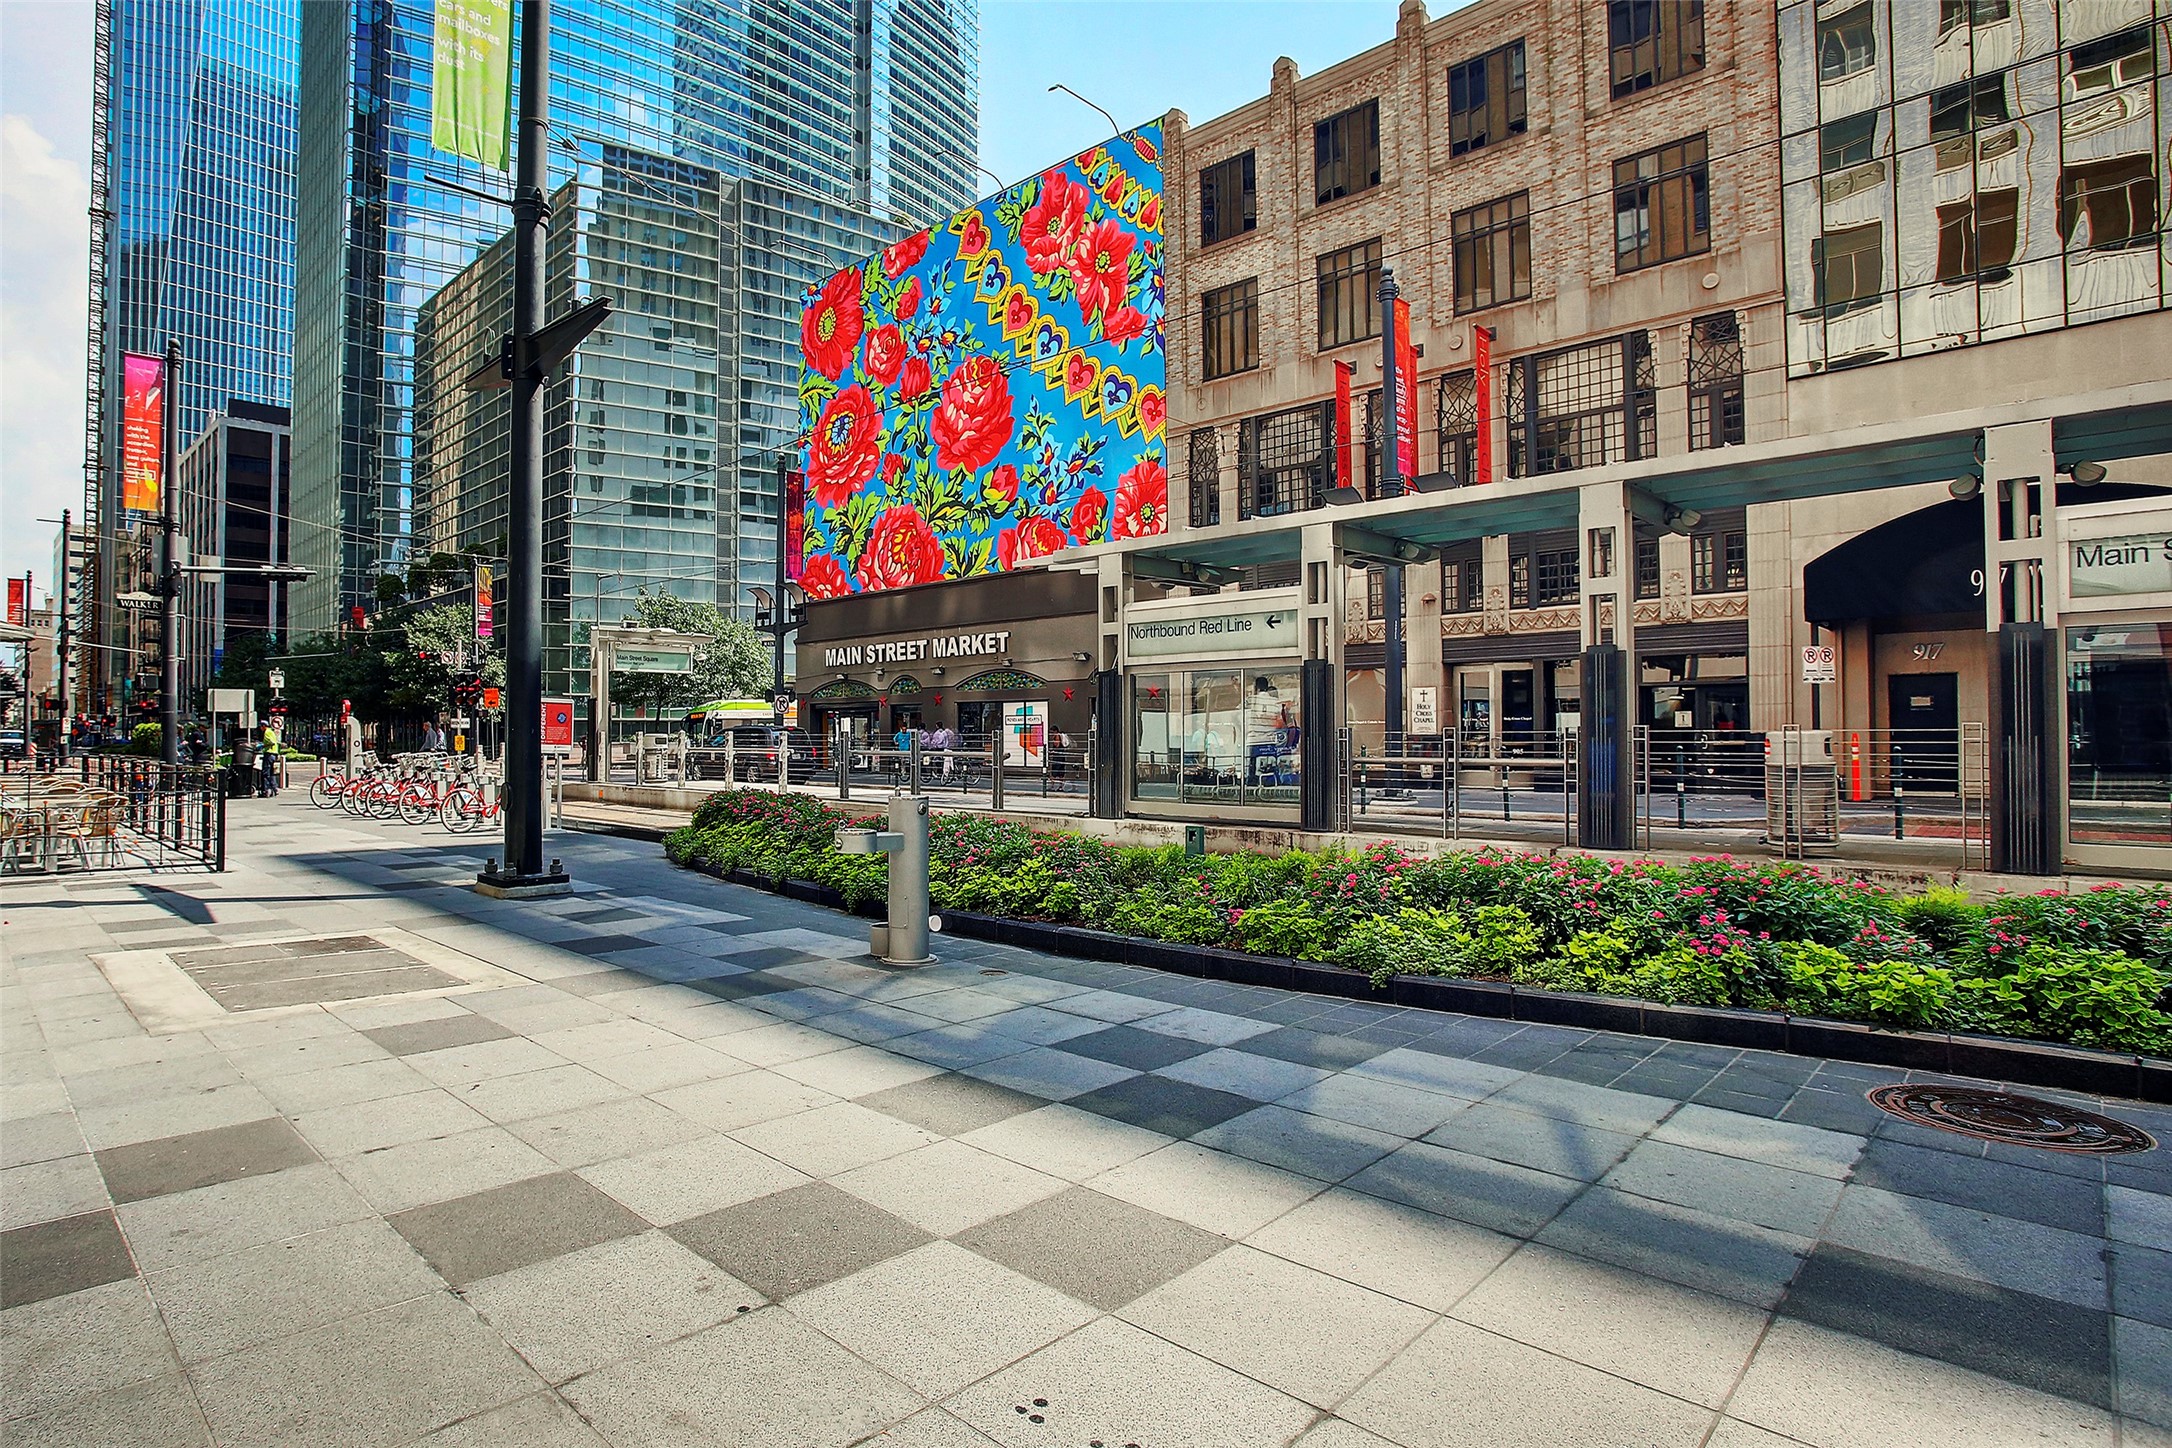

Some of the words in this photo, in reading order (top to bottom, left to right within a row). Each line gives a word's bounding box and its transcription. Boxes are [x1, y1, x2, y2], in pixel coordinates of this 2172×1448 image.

[439, 0, 465, 15] cars
[468, 10, 491, 26] and
[439, 14, 500, 46] mailboxes
[469, 46, 484, 62] its
[1478, 336, 1488, 386] Holy
[2076, 543, 2149, 568] Main
[120, 599, 159, 609] WALKER
[1130, 622, 1196, 640] Northbound
[1199, 619, 1223, 635] Red
[1227, 618, 1252, 632] Line
[825, 646, 863, 667] MAIN
[866, 639, 928, 664] STREET
[932, 631, 1009, 658] MARKET
[1912, 642, 1945, 662] 917
